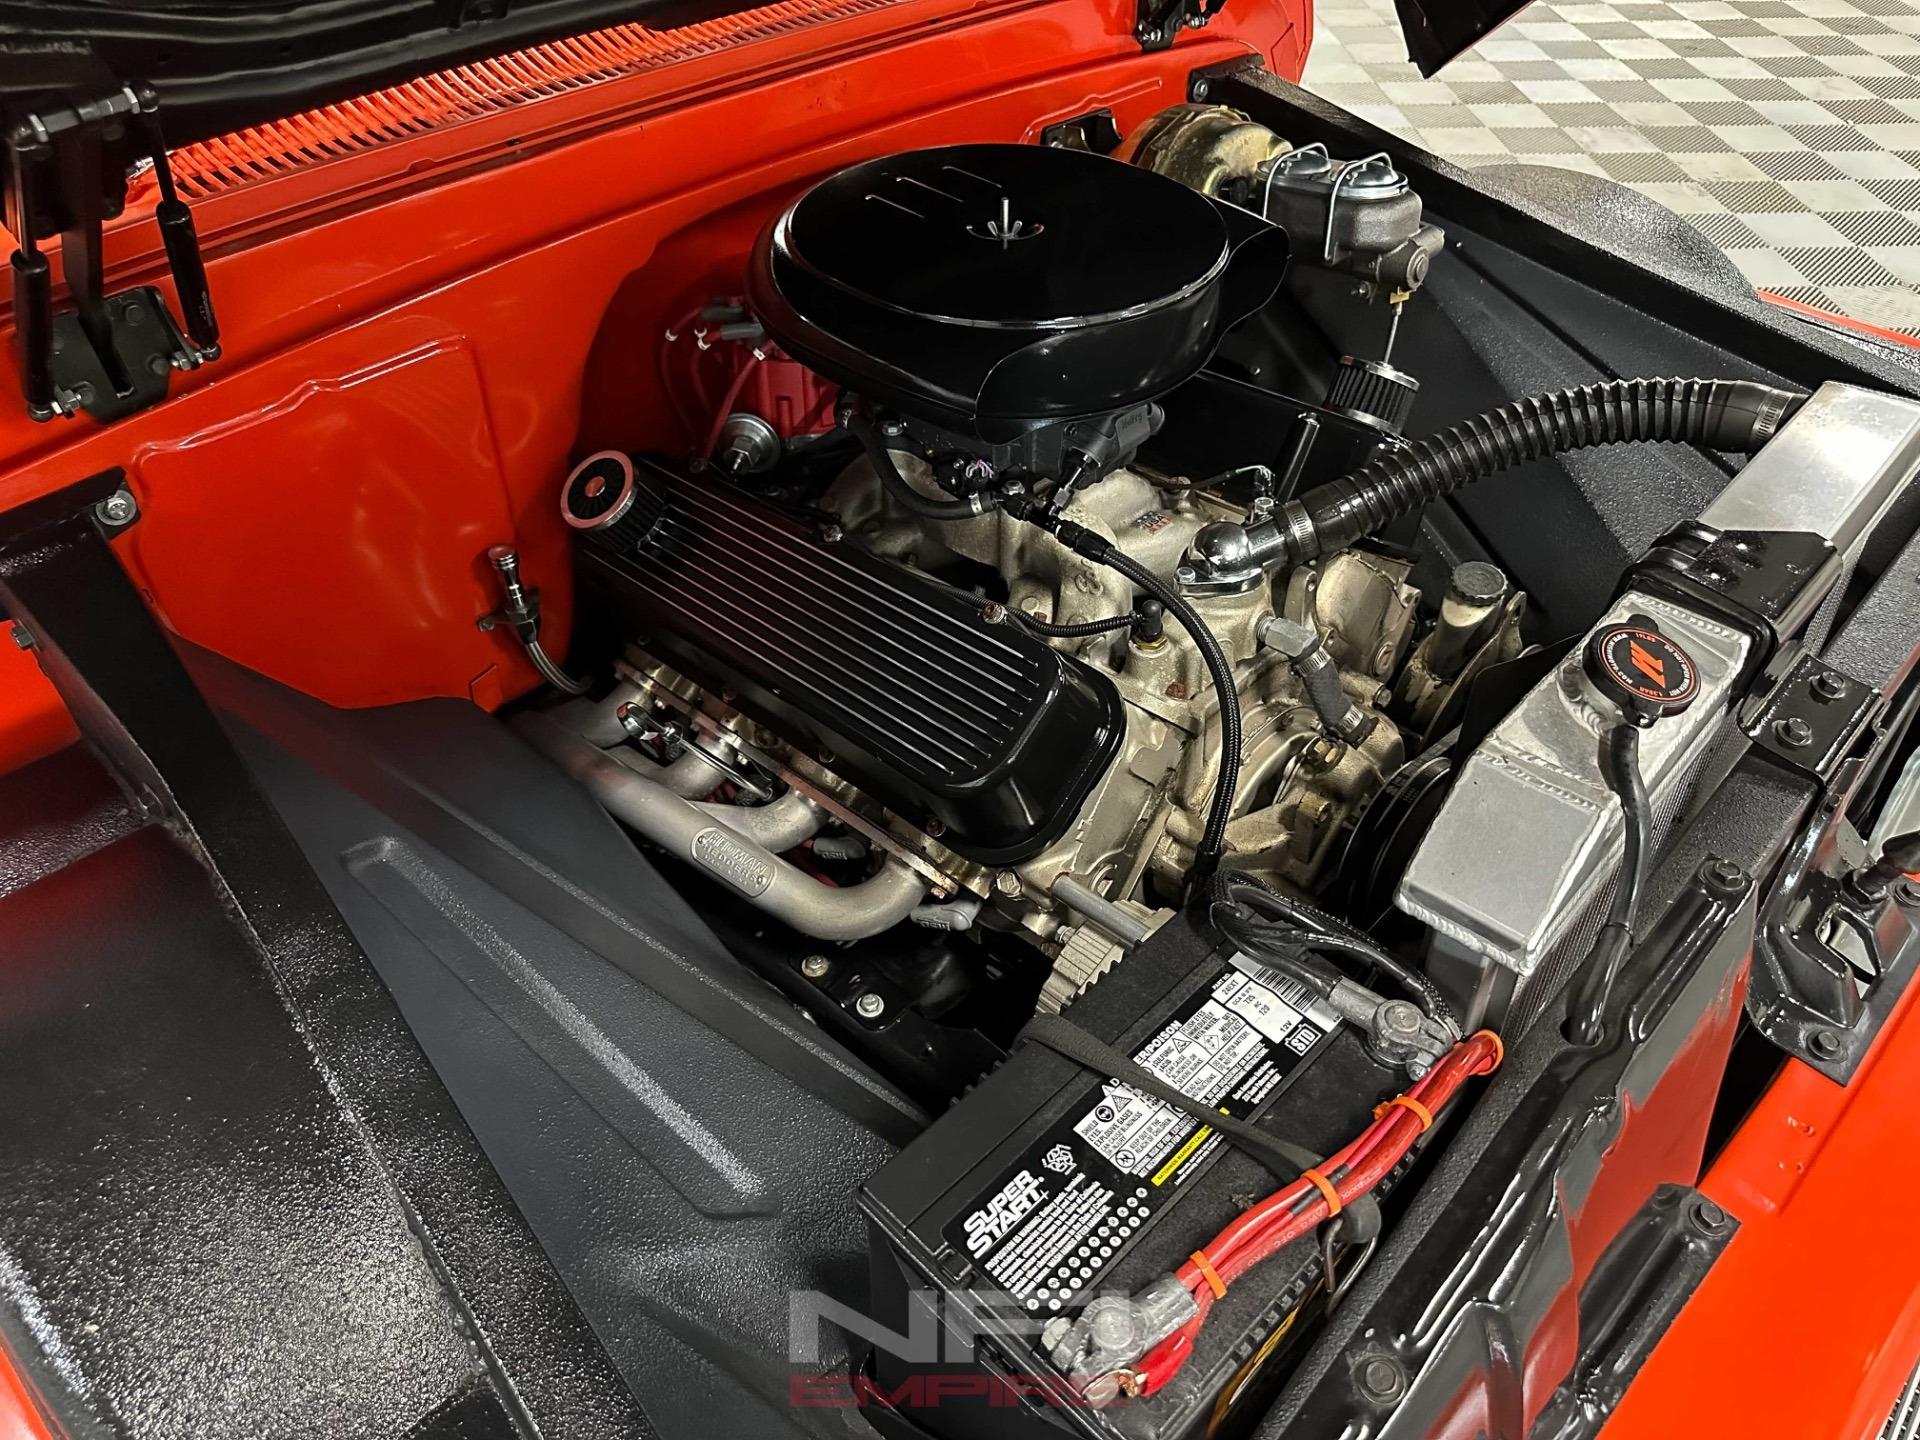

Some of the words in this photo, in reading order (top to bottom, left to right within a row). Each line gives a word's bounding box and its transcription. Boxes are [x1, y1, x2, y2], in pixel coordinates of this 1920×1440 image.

[1144, 515, 1164, 529] USA
[1673, 652, 1684, 664] NOT
[1243, 993, 1255, 1005] 725
[1220, 1030, 1232, 1042] HELP
[1230, 1020, 1242, 1032] FAST
[1279, 1020, 1292, 1033] 12V
[1290, 1026, 1316, 1053] STD
[1093, 1122, 1119, 1147] EXPLOSIVE
[1116, 1108, 1133, 1125] GASES
[964, 1169, 1035, 1235] SUPER
